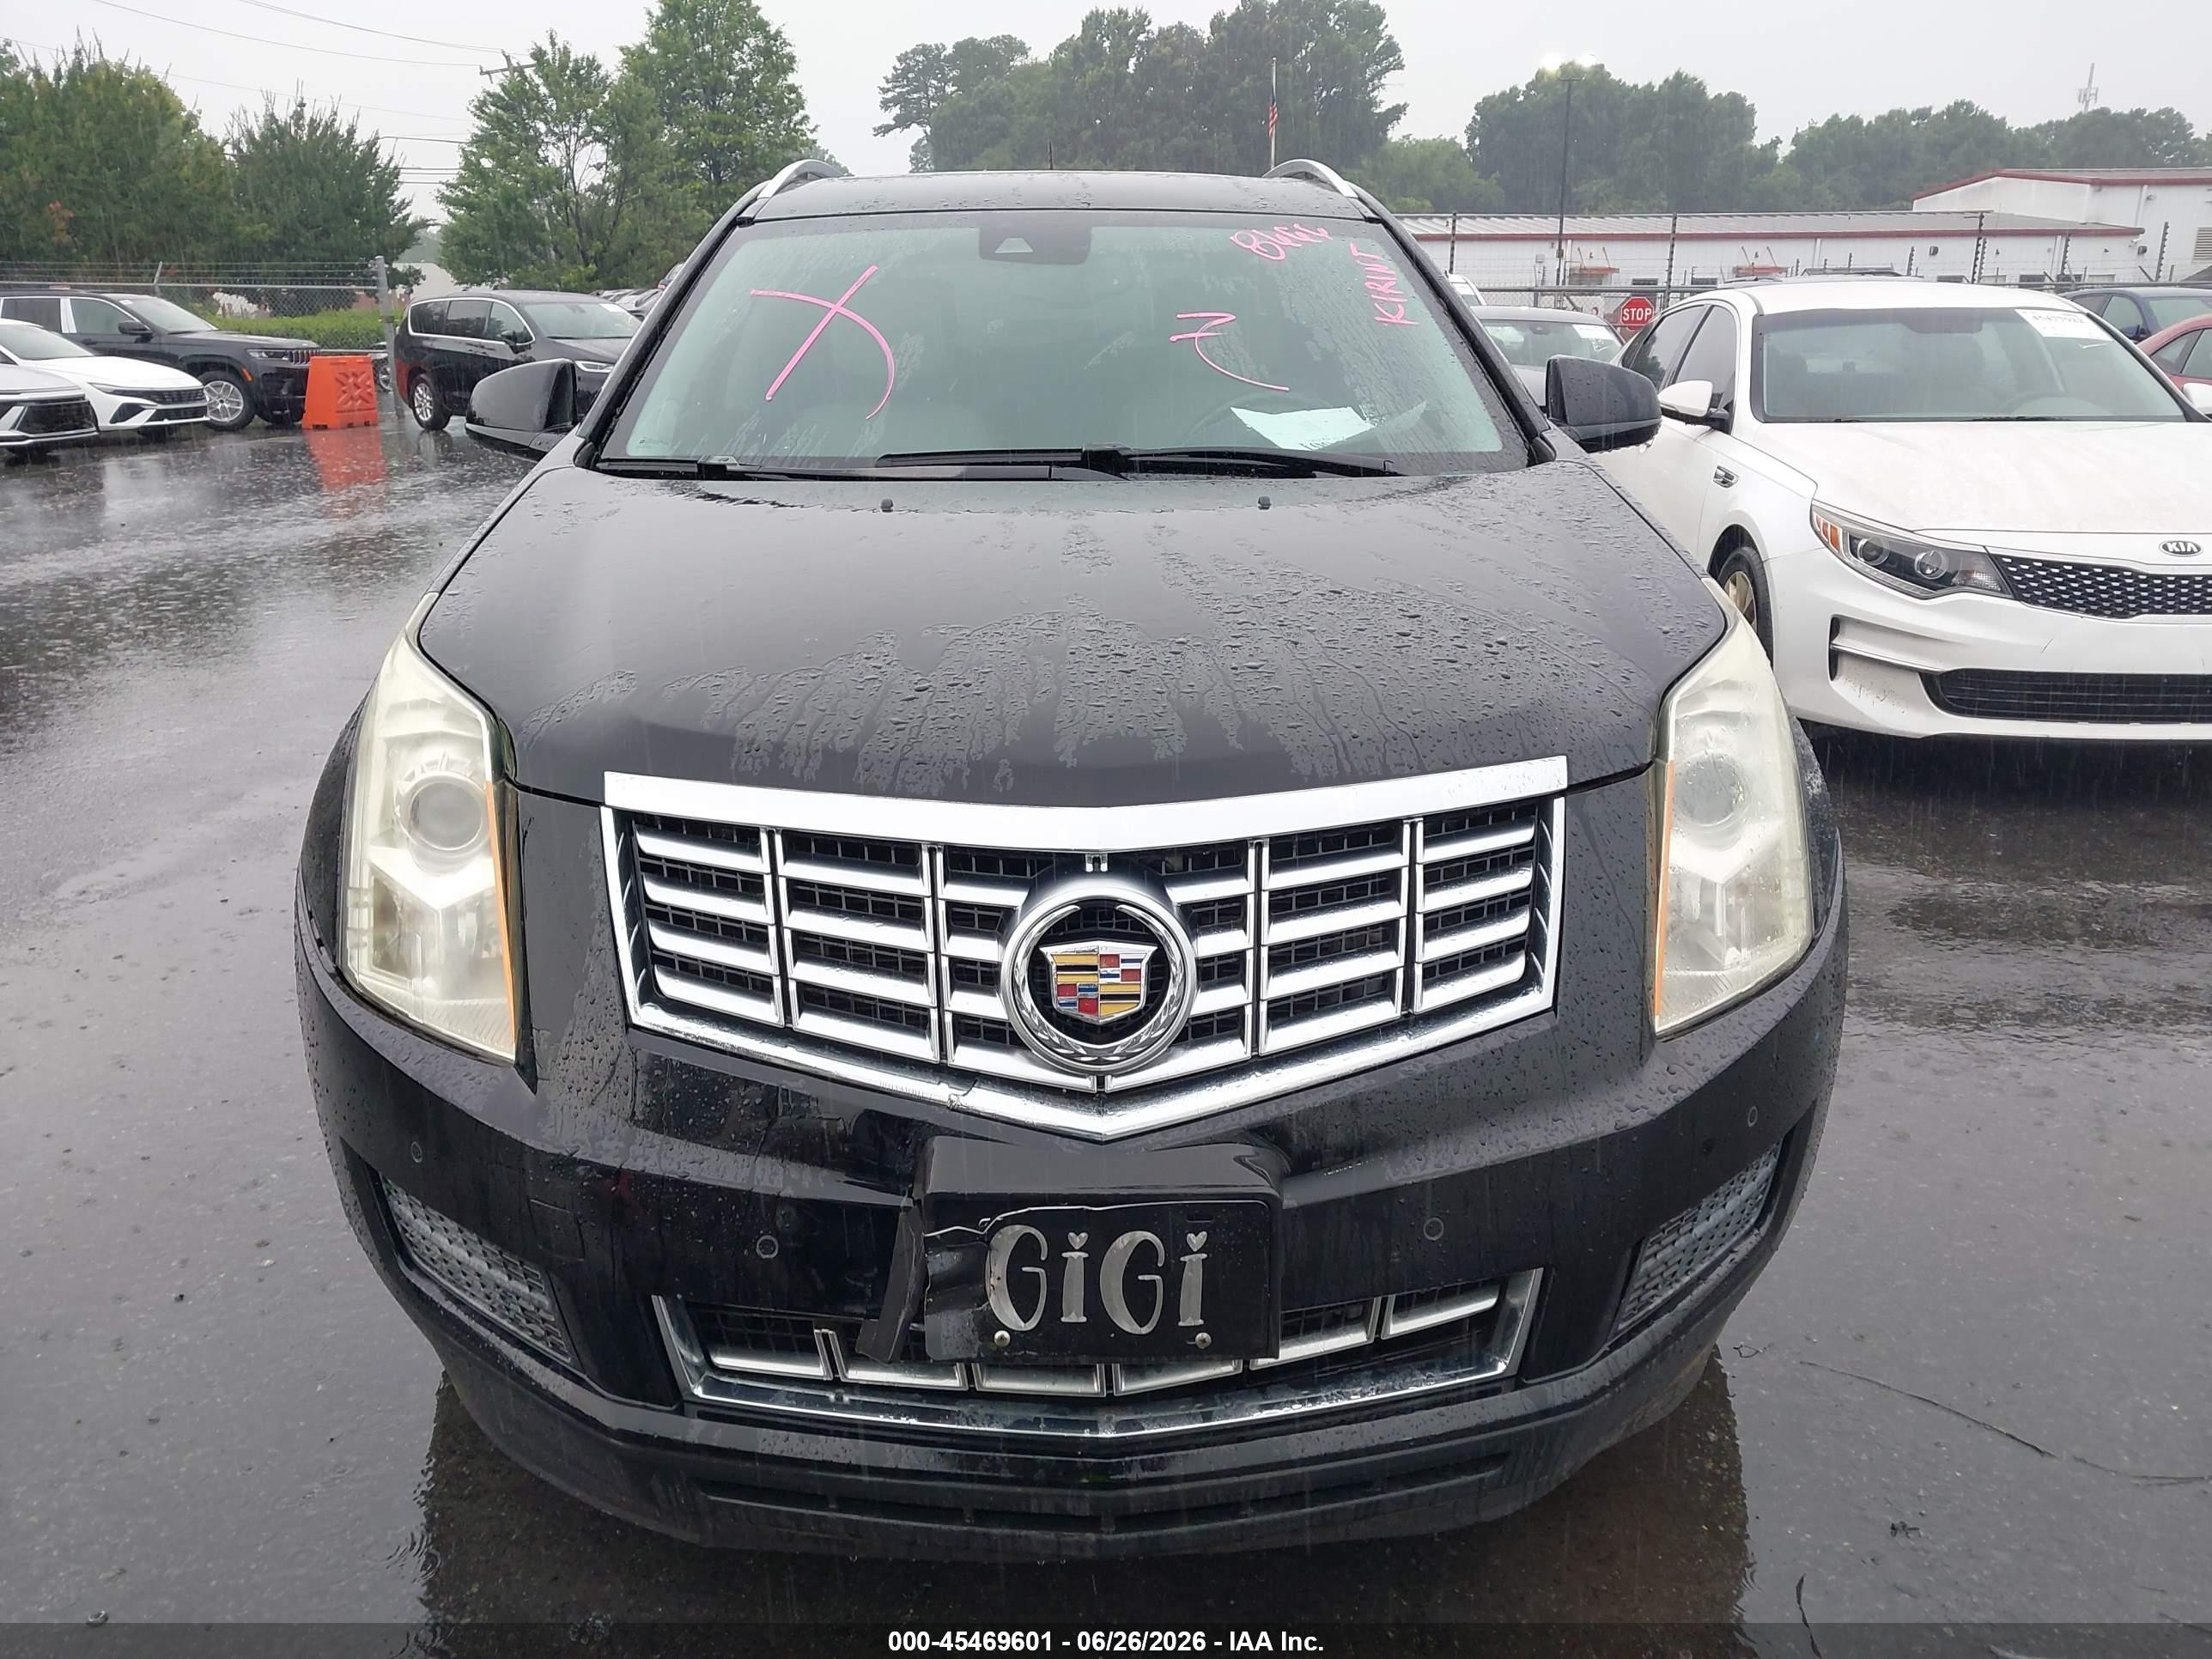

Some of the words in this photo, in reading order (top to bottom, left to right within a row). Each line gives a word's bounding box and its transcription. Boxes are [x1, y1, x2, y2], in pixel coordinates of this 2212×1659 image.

[1623, 307, 1652, 321] STOP
[2166, 541, 2199, 552] KIA
[985, 1224, 1208, 1335] GiGi
